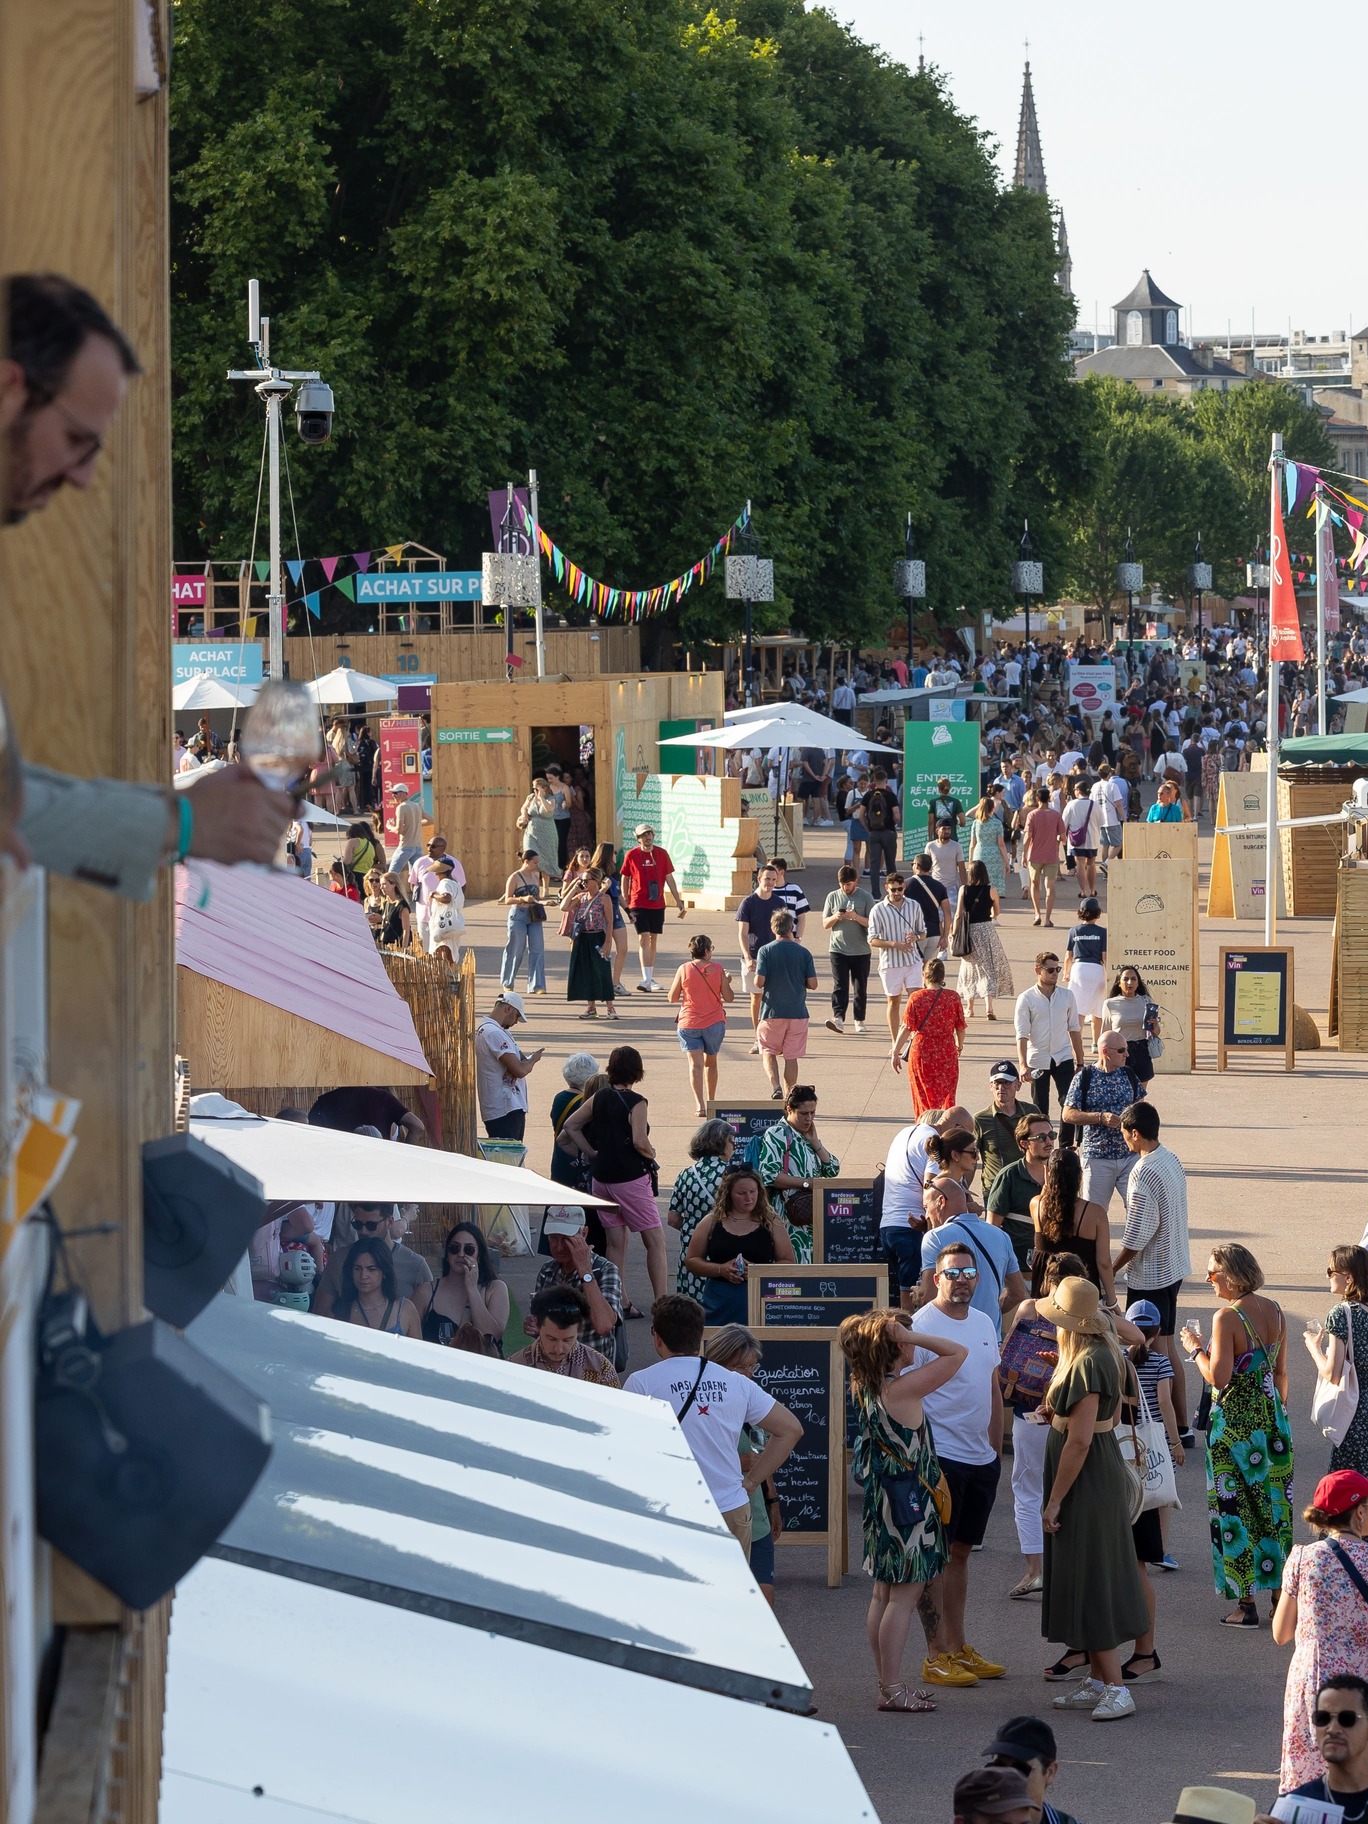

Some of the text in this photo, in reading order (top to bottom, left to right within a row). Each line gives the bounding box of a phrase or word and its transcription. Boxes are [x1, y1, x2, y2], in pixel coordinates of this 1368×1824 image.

[360, 579, 422, 596] ACHAT
[427, 578, 464, 595] SUR
[189, 650, 233, 661] ACHAT
[397, 654, 419, 671] 10
[176, 666, 247, 678] SUR PLACE
[439, 732, 480, 741] SORTIE
[383, 740, 390, 752] 1
[383, 760, 392, 772] 2
[384, 781, 392, 793] 3
[910, 784, 972, 795] RÉ-EMOYEZ
[830, 1205, 850, 1214] Vin
[670, 1380, 692, 1394] NASI
[771, 1387, 826, 1400] moyennes
